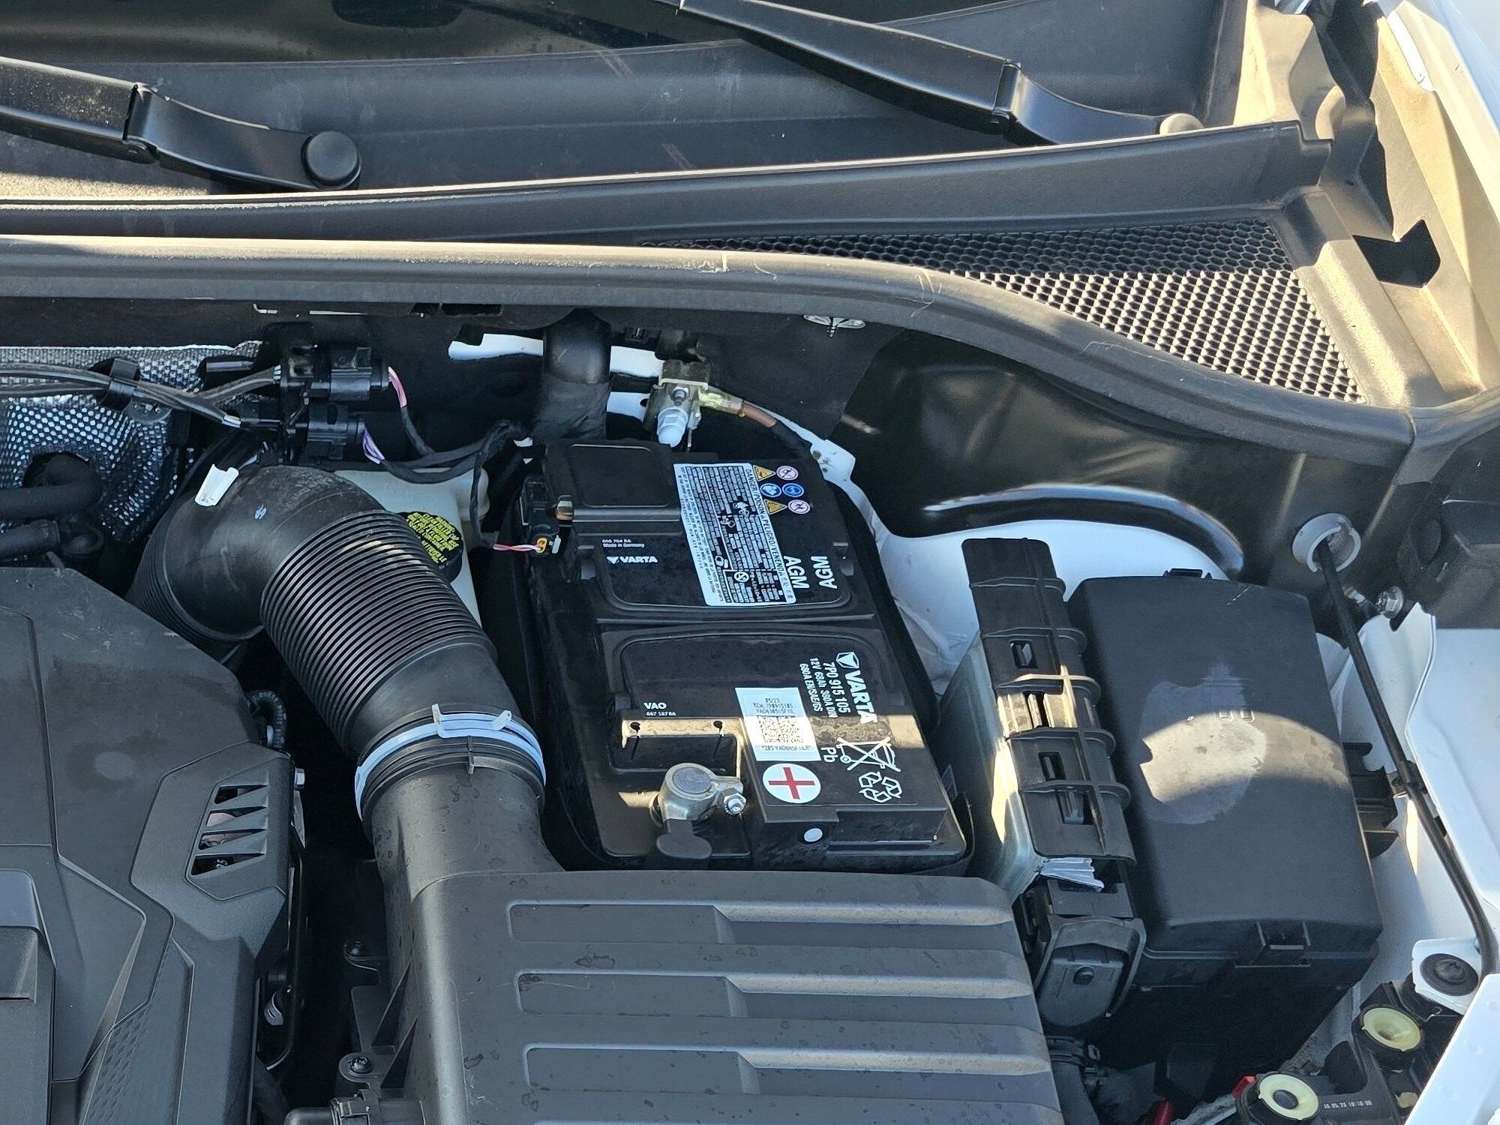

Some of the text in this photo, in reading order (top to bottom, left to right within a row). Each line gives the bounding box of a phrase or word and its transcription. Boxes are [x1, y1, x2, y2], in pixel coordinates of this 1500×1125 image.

[784, 555, 810, 589] AGM
[810, 555, 838, 589] AGM
[809, 657, 822, 670] 12V
[823, 661, 852, 713] 7P0 915 105
[844, 669, 878, 725] VARTA
[820, 746, 839, 763] Pb
